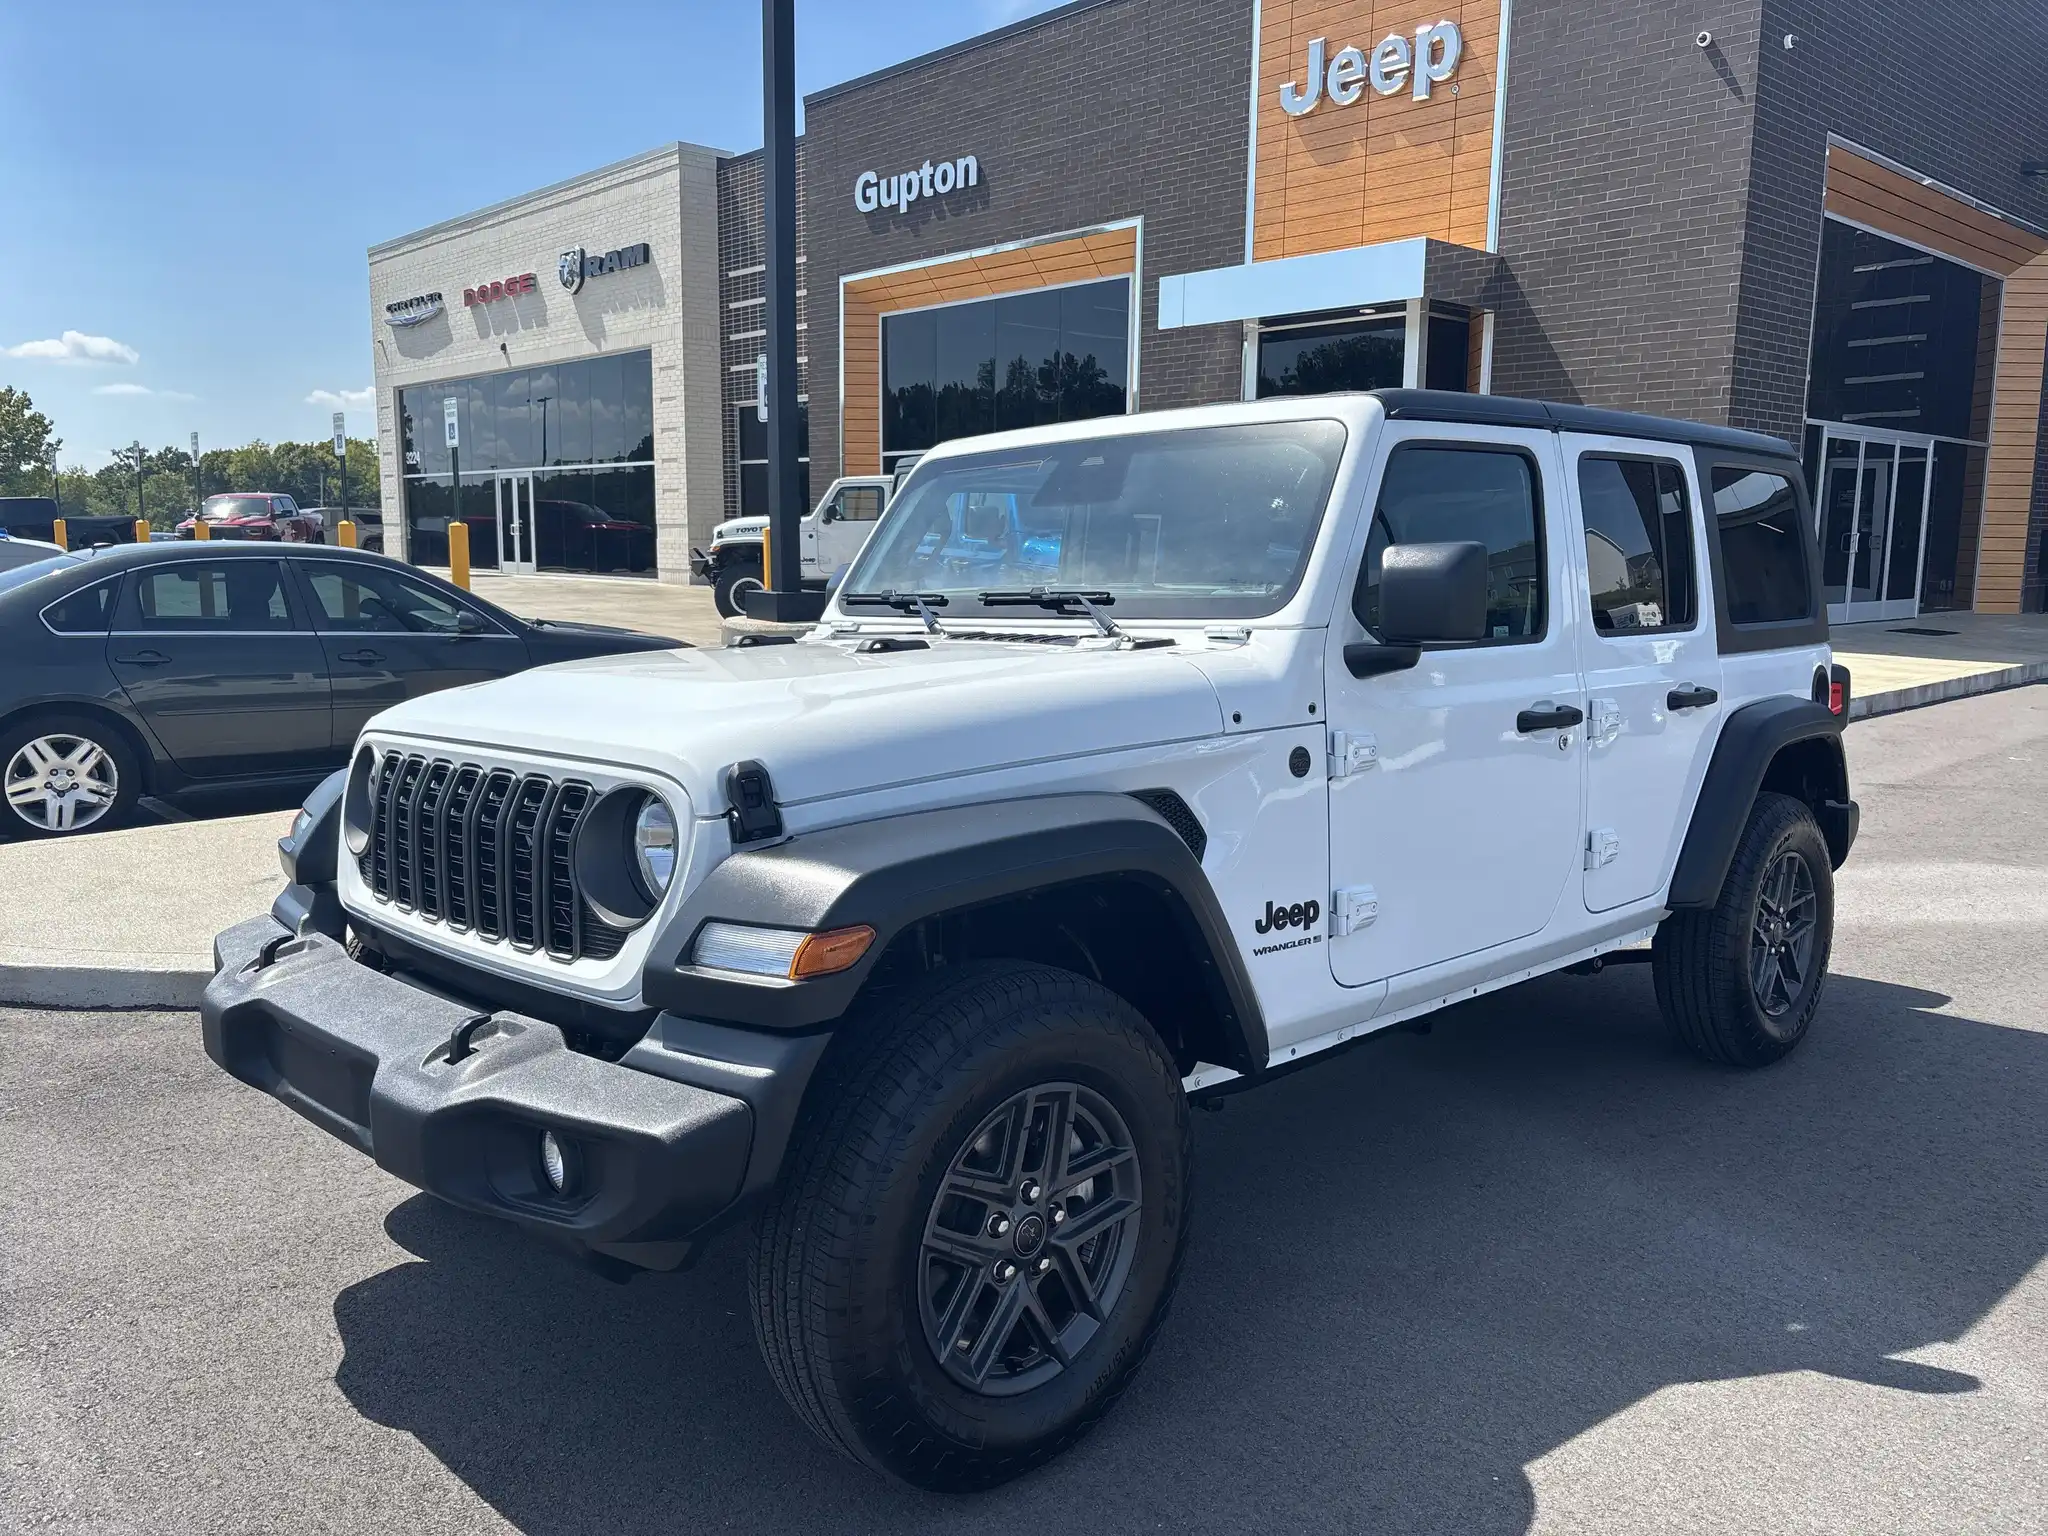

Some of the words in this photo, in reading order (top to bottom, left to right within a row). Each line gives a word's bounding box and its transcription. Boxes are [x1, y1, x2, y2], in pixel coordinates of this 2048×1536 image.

[1280, 19, 1462, 116] Jeep
[854, 155, 978, 213] Gupton
[584, 243, 648, 277] RAM
[386, 292, 443, 313] CHRYSLER
[463, 273, 536, 307] DODGE
[1255, 900, 1320, 934] Jeep
[1253, 937, 1312, 956] WRANGLER
